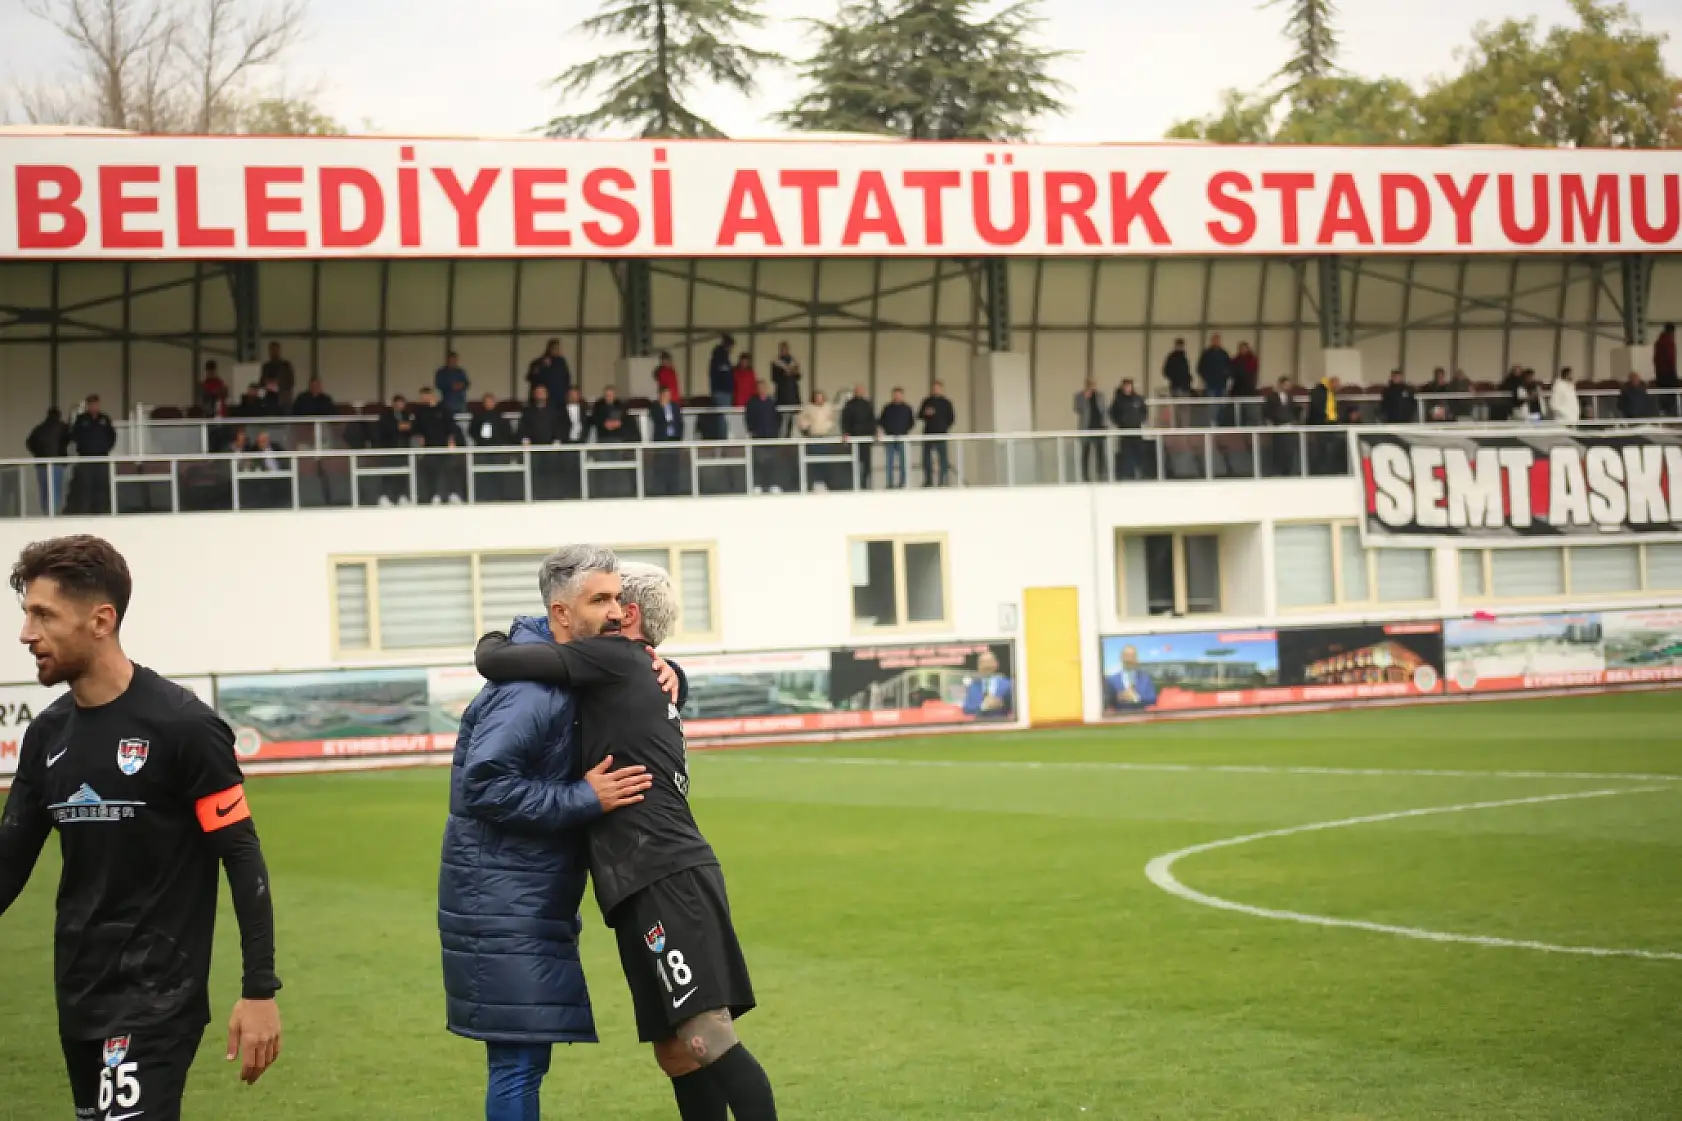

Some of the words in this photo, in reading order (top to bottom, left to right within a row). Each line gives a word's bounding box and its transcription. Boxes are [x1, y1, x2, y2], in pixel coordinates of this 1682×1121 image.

[15, 146, 673, 249] BELEDİYESİ
[717, 153, 1169, 246] ATATÜRK
[1206, 171, 1681, 246] STADYUMU
[1371, 443, 1534, 527] SEMT
[656, 948, 692, 993] 18
[98, 1061, 141, 1111] 65
